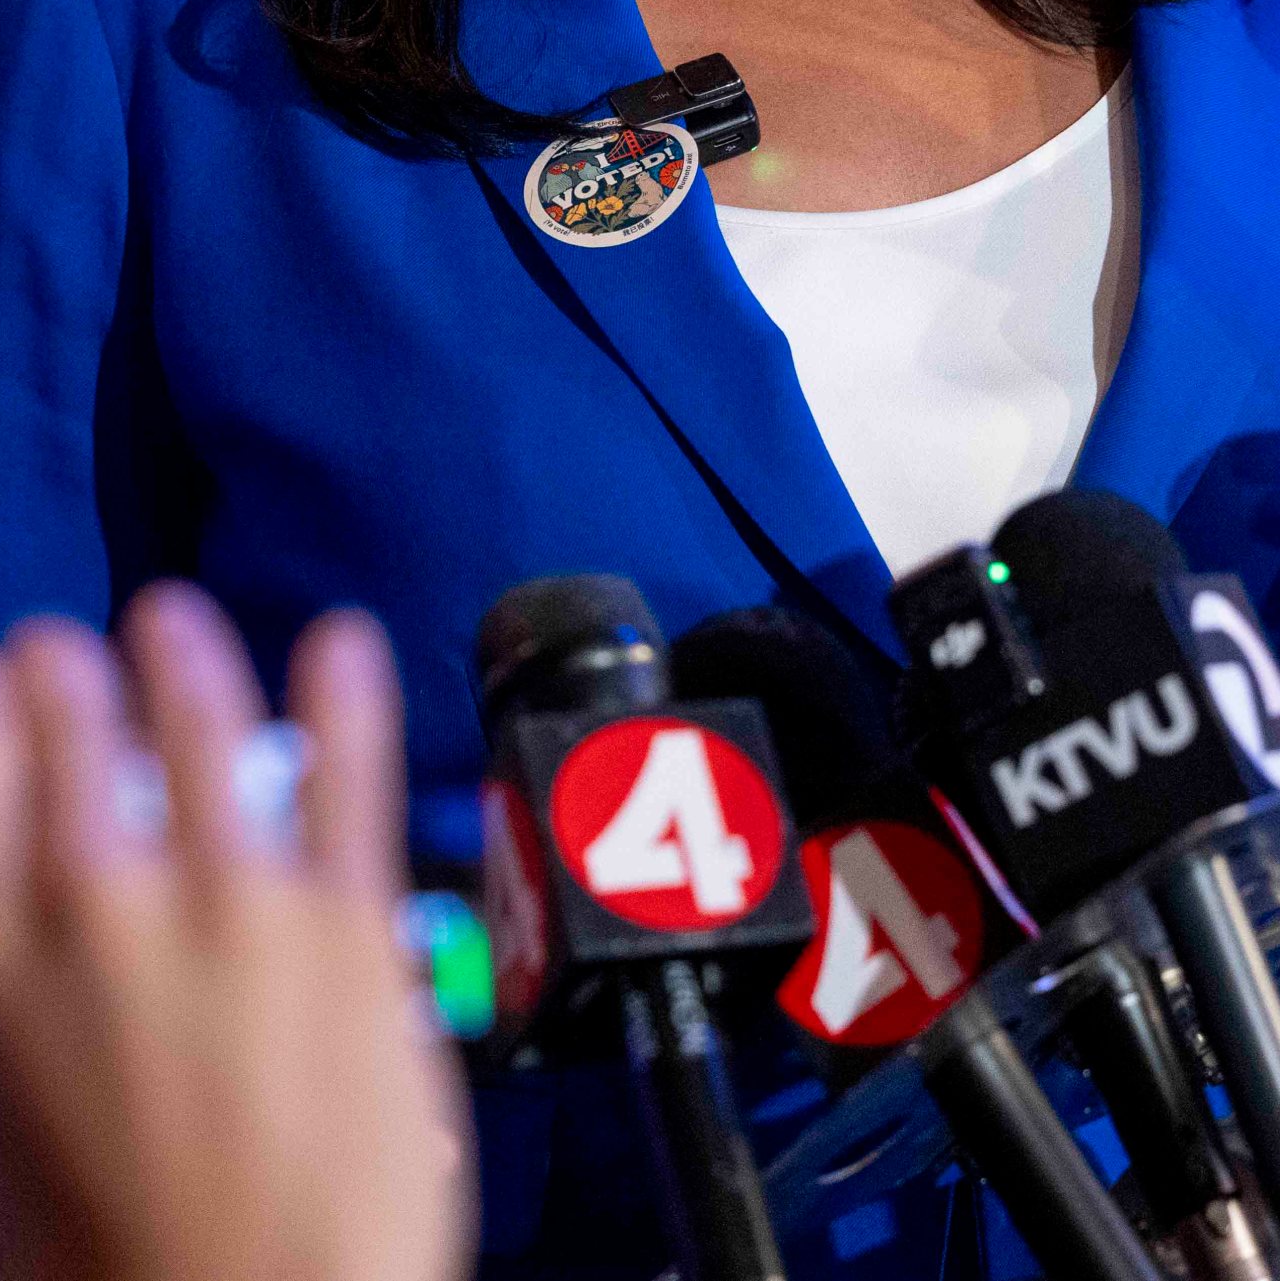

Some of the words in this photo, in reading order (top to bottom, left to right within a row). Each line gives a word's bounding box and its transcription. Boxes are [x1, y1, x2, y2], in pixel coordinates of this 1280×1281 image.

[552, 147, 675, 210] VOTED!
[595, 153, 611, 168] I
[583, 727, 755, 916] 4
[990, 673, 1198, 828] KTVU
[811, 827, 967, 1034] 4
